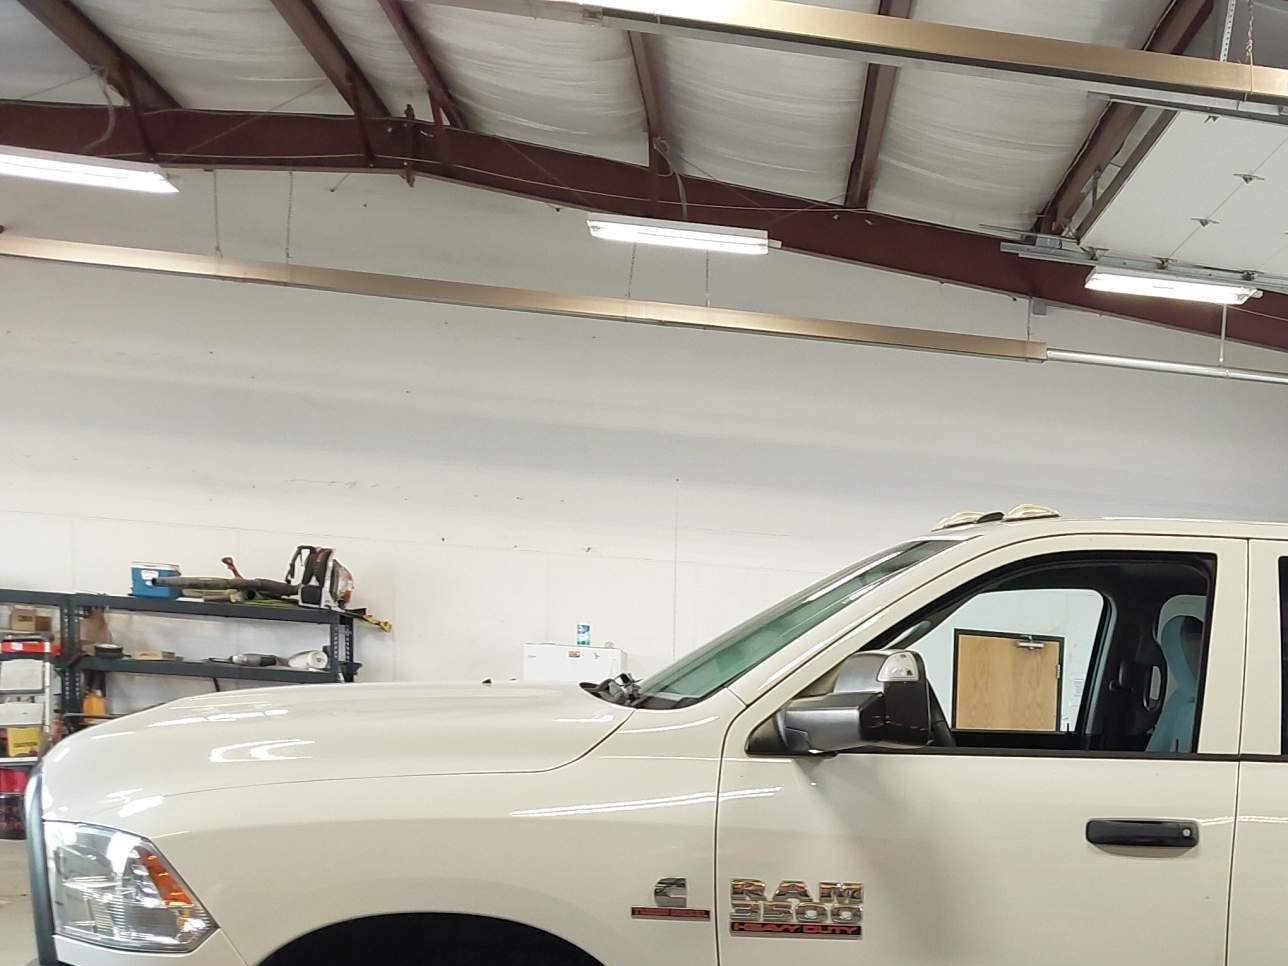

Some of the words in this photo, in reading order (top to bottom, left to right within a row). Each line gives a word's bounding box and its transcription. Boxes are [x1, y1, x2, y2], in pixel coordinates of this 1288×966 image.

[731, 878, 864, 904] RAM
[730, 901, 864, 924] 3500
[734, 923, 798, 934] HEAVY
[803, 926, 860, 935] DUTY
